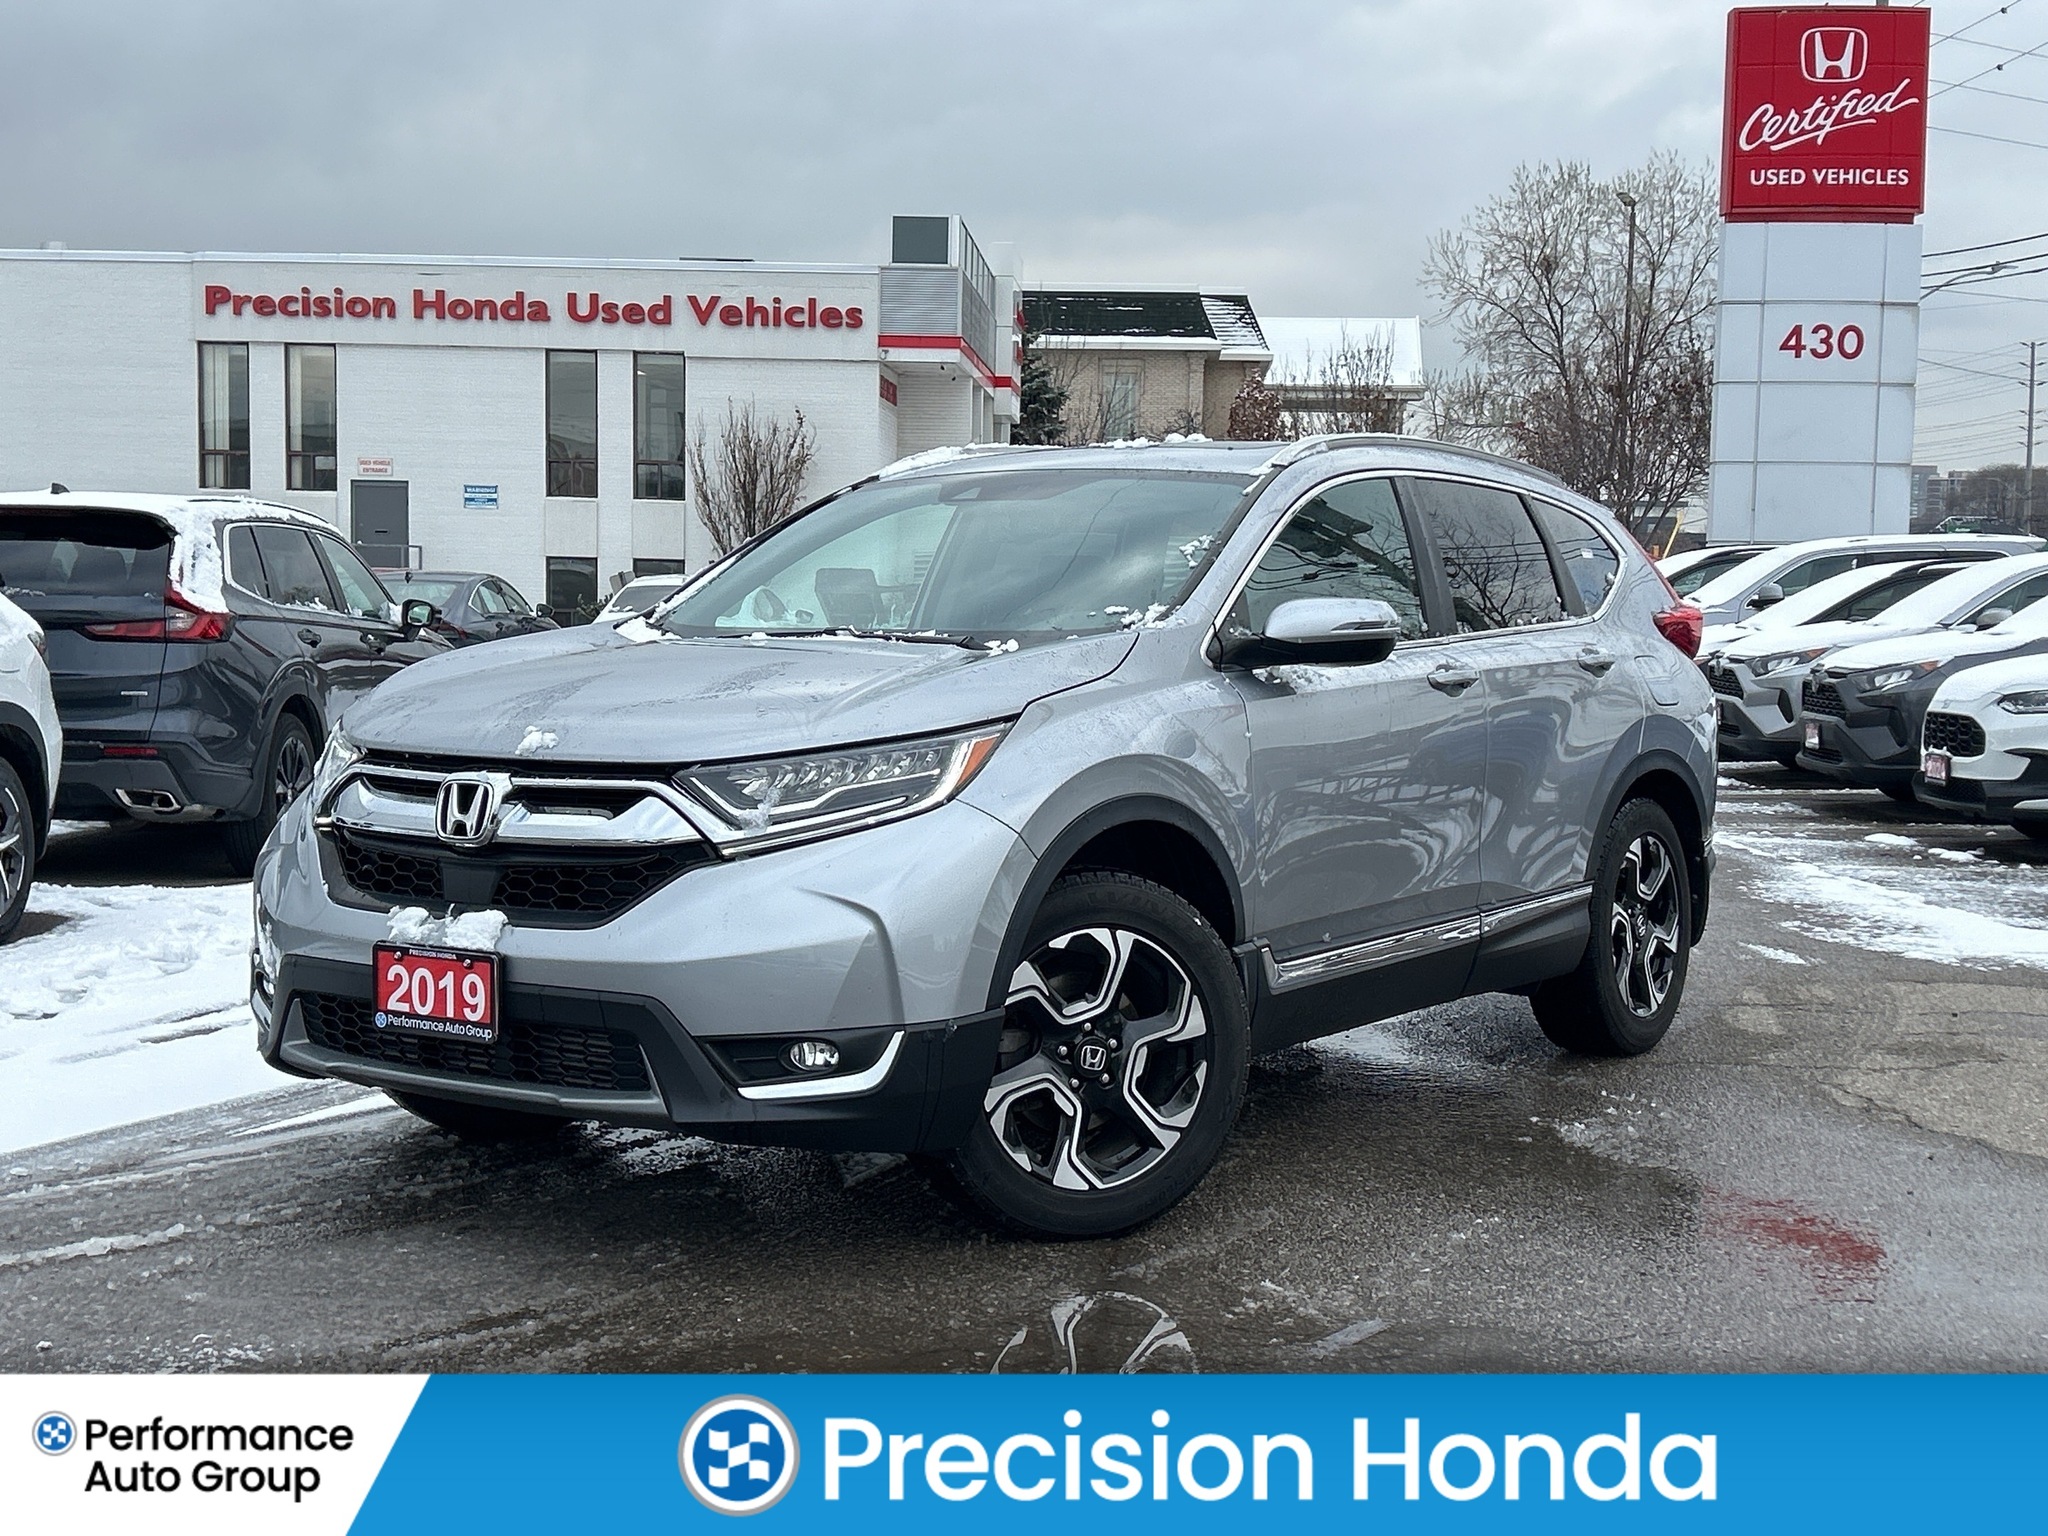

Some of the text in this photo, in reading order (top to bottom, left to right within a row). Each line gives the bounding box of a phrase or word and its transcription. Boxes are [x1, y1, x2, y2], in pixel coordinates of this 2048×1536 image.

[1738, 78, 1919, 150] Certified
[1750, 167, 1909, 186] USED VEHICLES
[204, 285, 863, 329] Precision Honda Used Vehicles
[1780, 324, 1864, 359] 430
[409, 949, 457, 960] PRECISION HONDA
[386, 964, 486, 1022] 2019
[387, 1014, 493, 1041] Performance Auto Group
